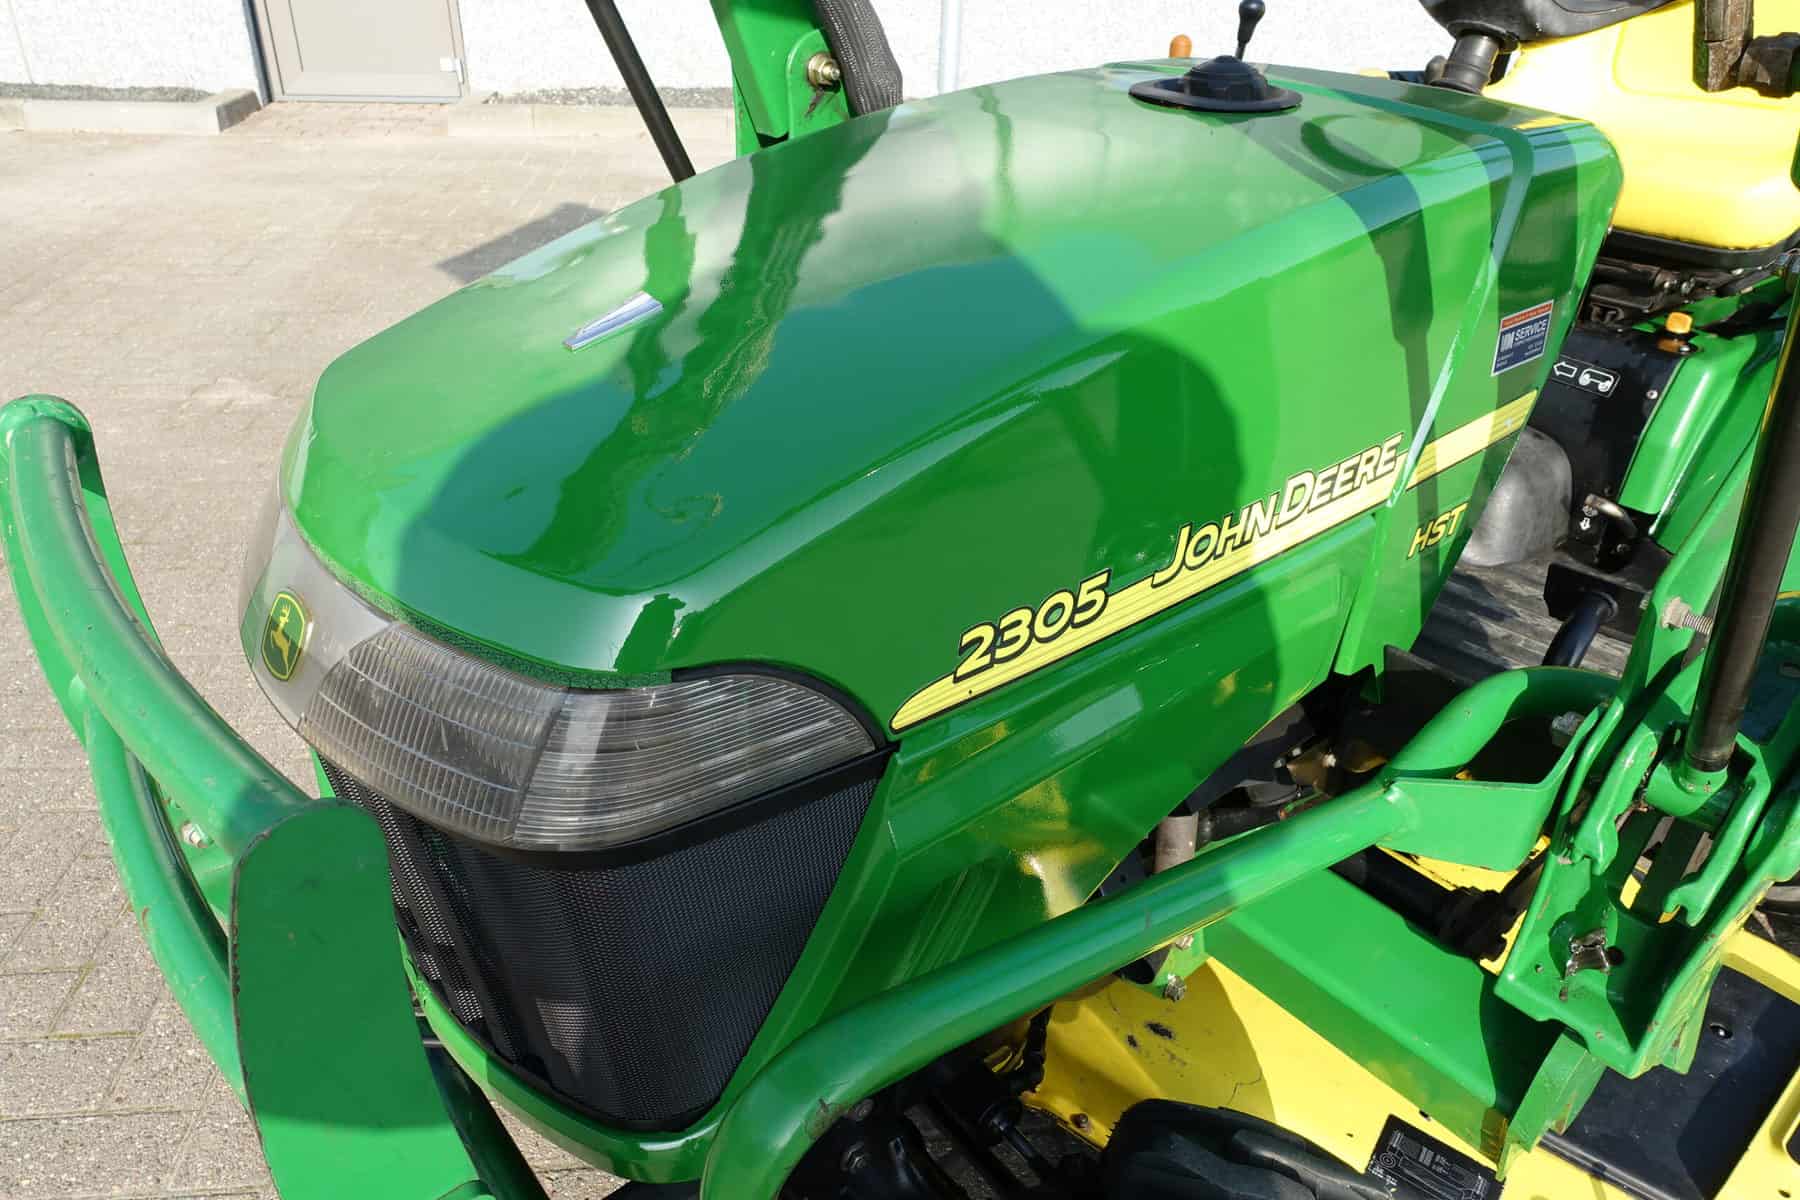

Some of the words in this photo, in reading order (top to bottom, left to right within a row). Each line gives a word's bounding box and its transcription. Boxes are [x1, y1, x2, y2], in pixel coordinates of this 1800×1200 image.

[1515, 319, 1547, 341] SERVICE
[1151, 491, 1280, 586] JOHN
[1275, 432, 1404, 529] DEERE
[1407, 502, 1470, 559] HST
[953, 568, 1111, 683] 2305
